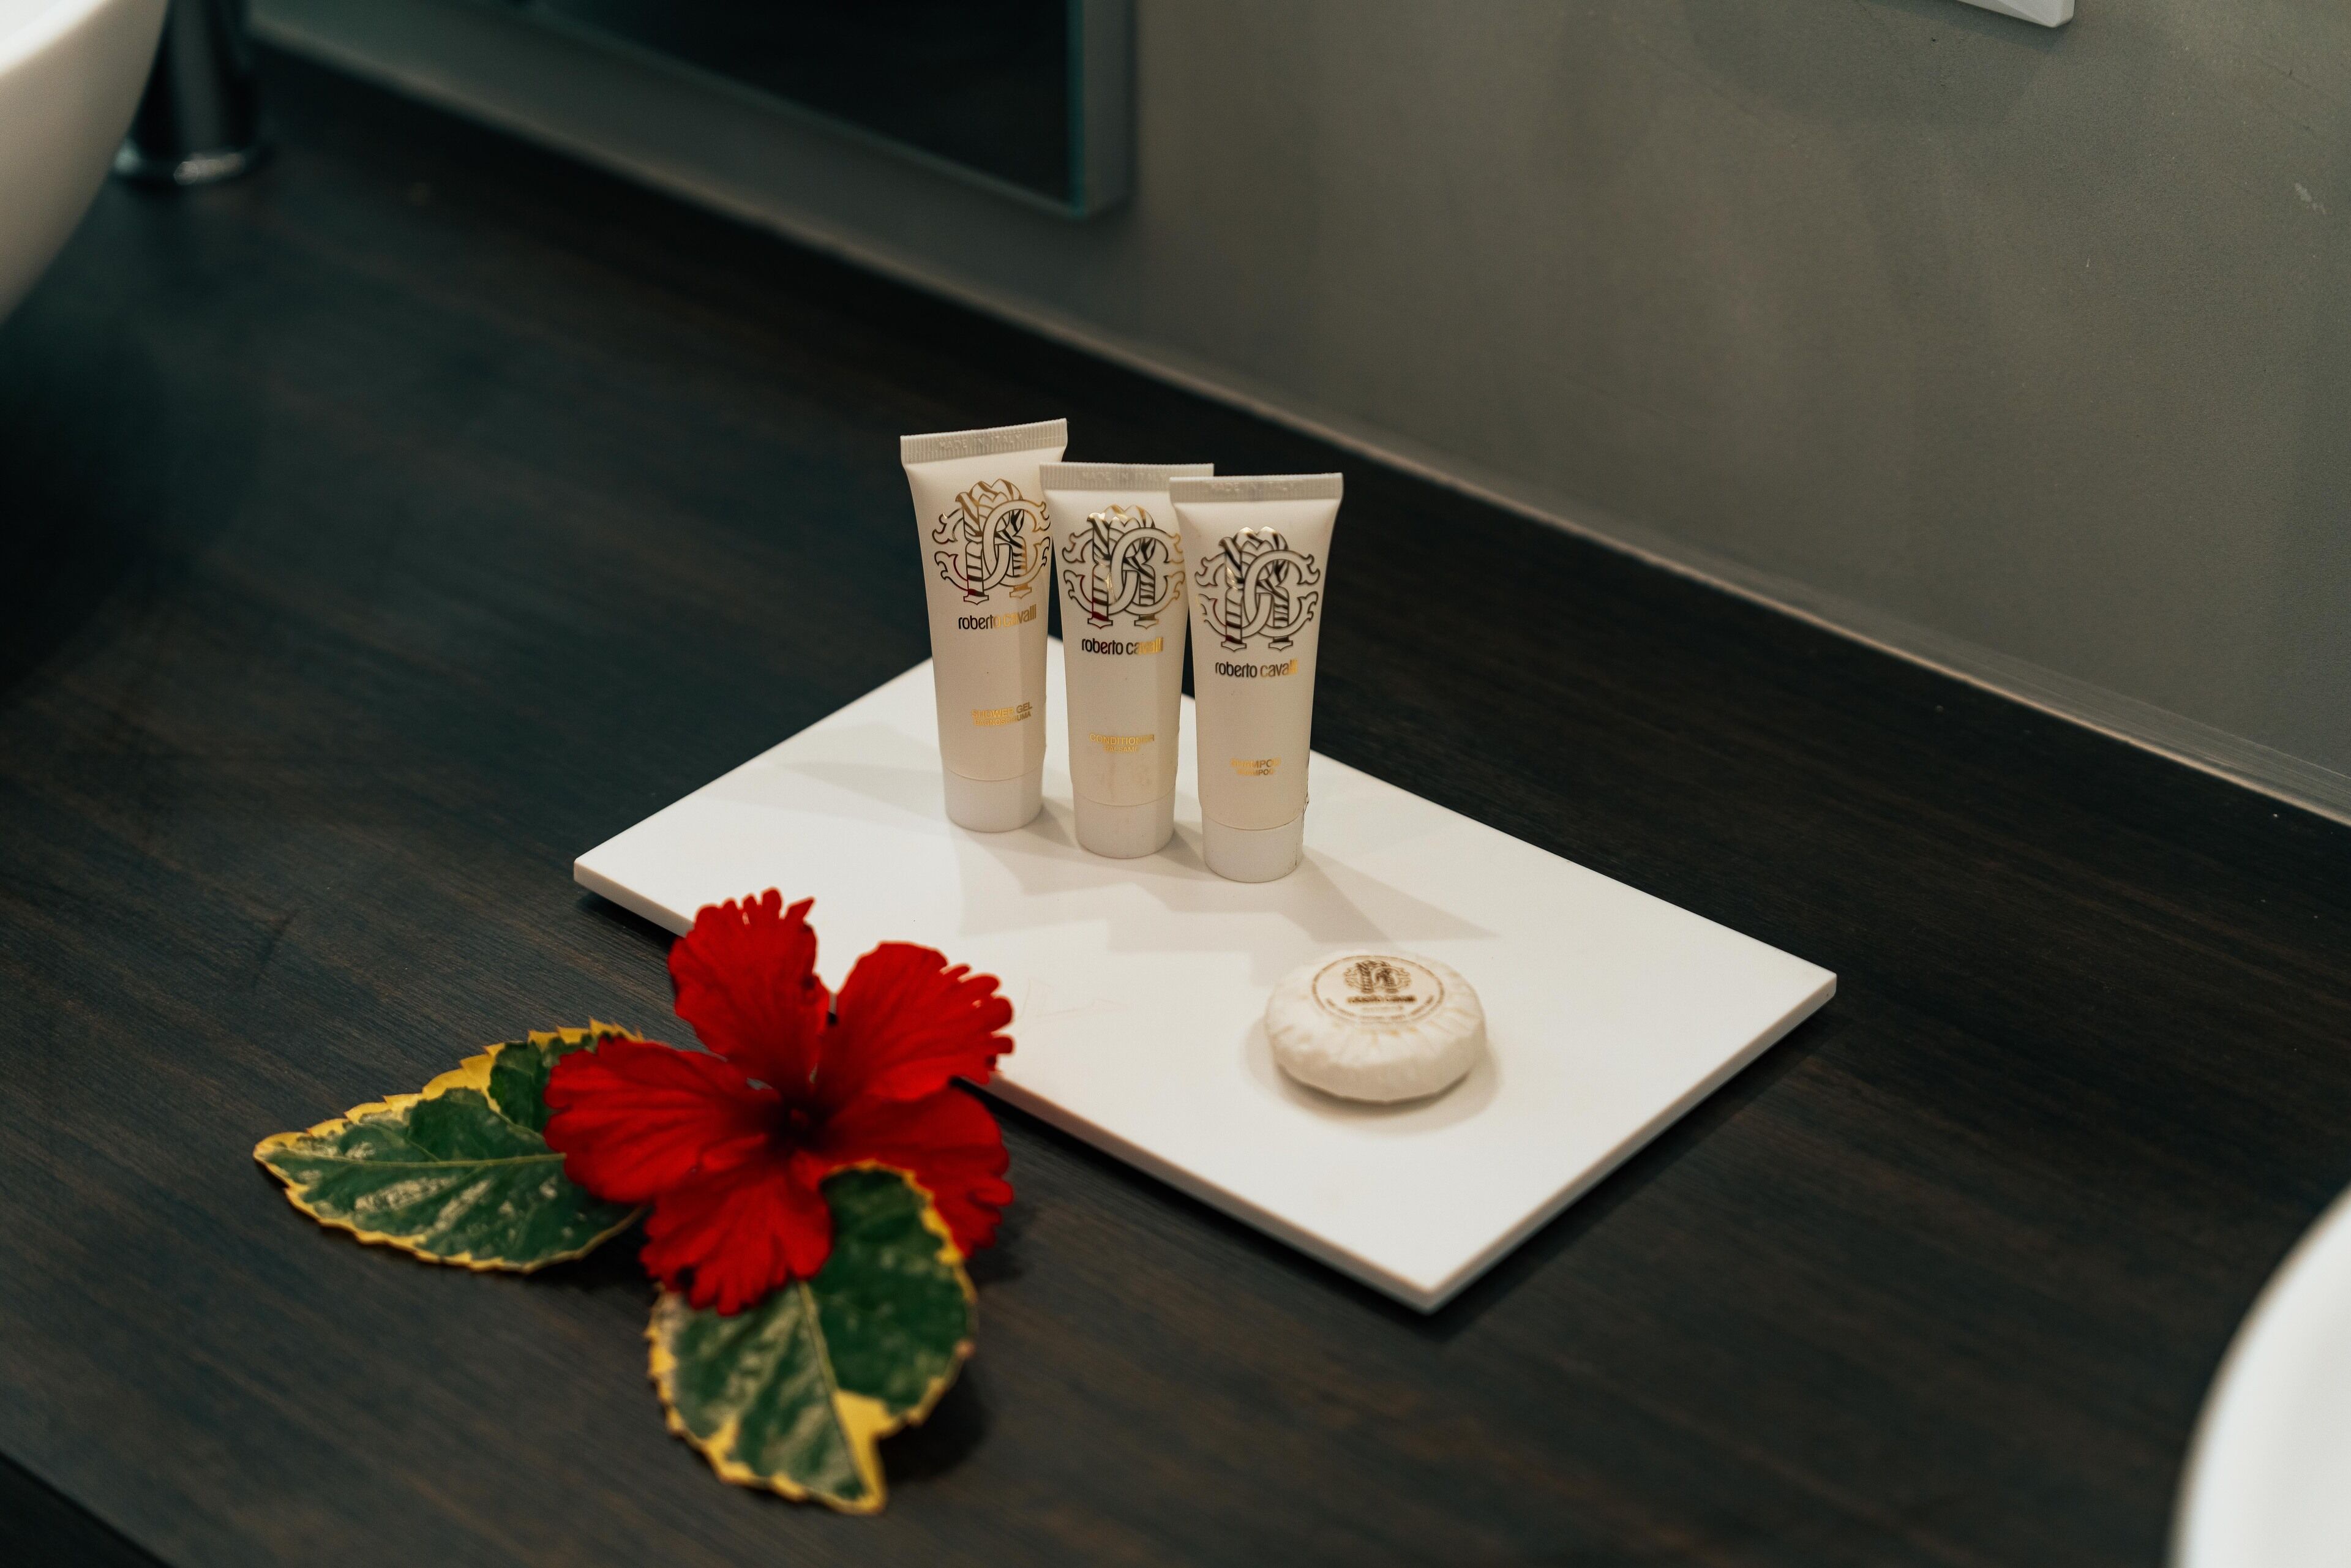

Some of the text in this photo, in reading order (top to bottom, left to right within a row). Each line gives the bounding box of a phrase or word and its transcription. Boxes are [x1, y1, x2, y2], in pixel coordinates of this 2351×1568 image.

[958, 614, 1001, 629] roberto
[1082, 637, 1123, 655] roberto
[1215, 661, 1258, 678] roberto
[1016, 702, 1033, 714] GEL
